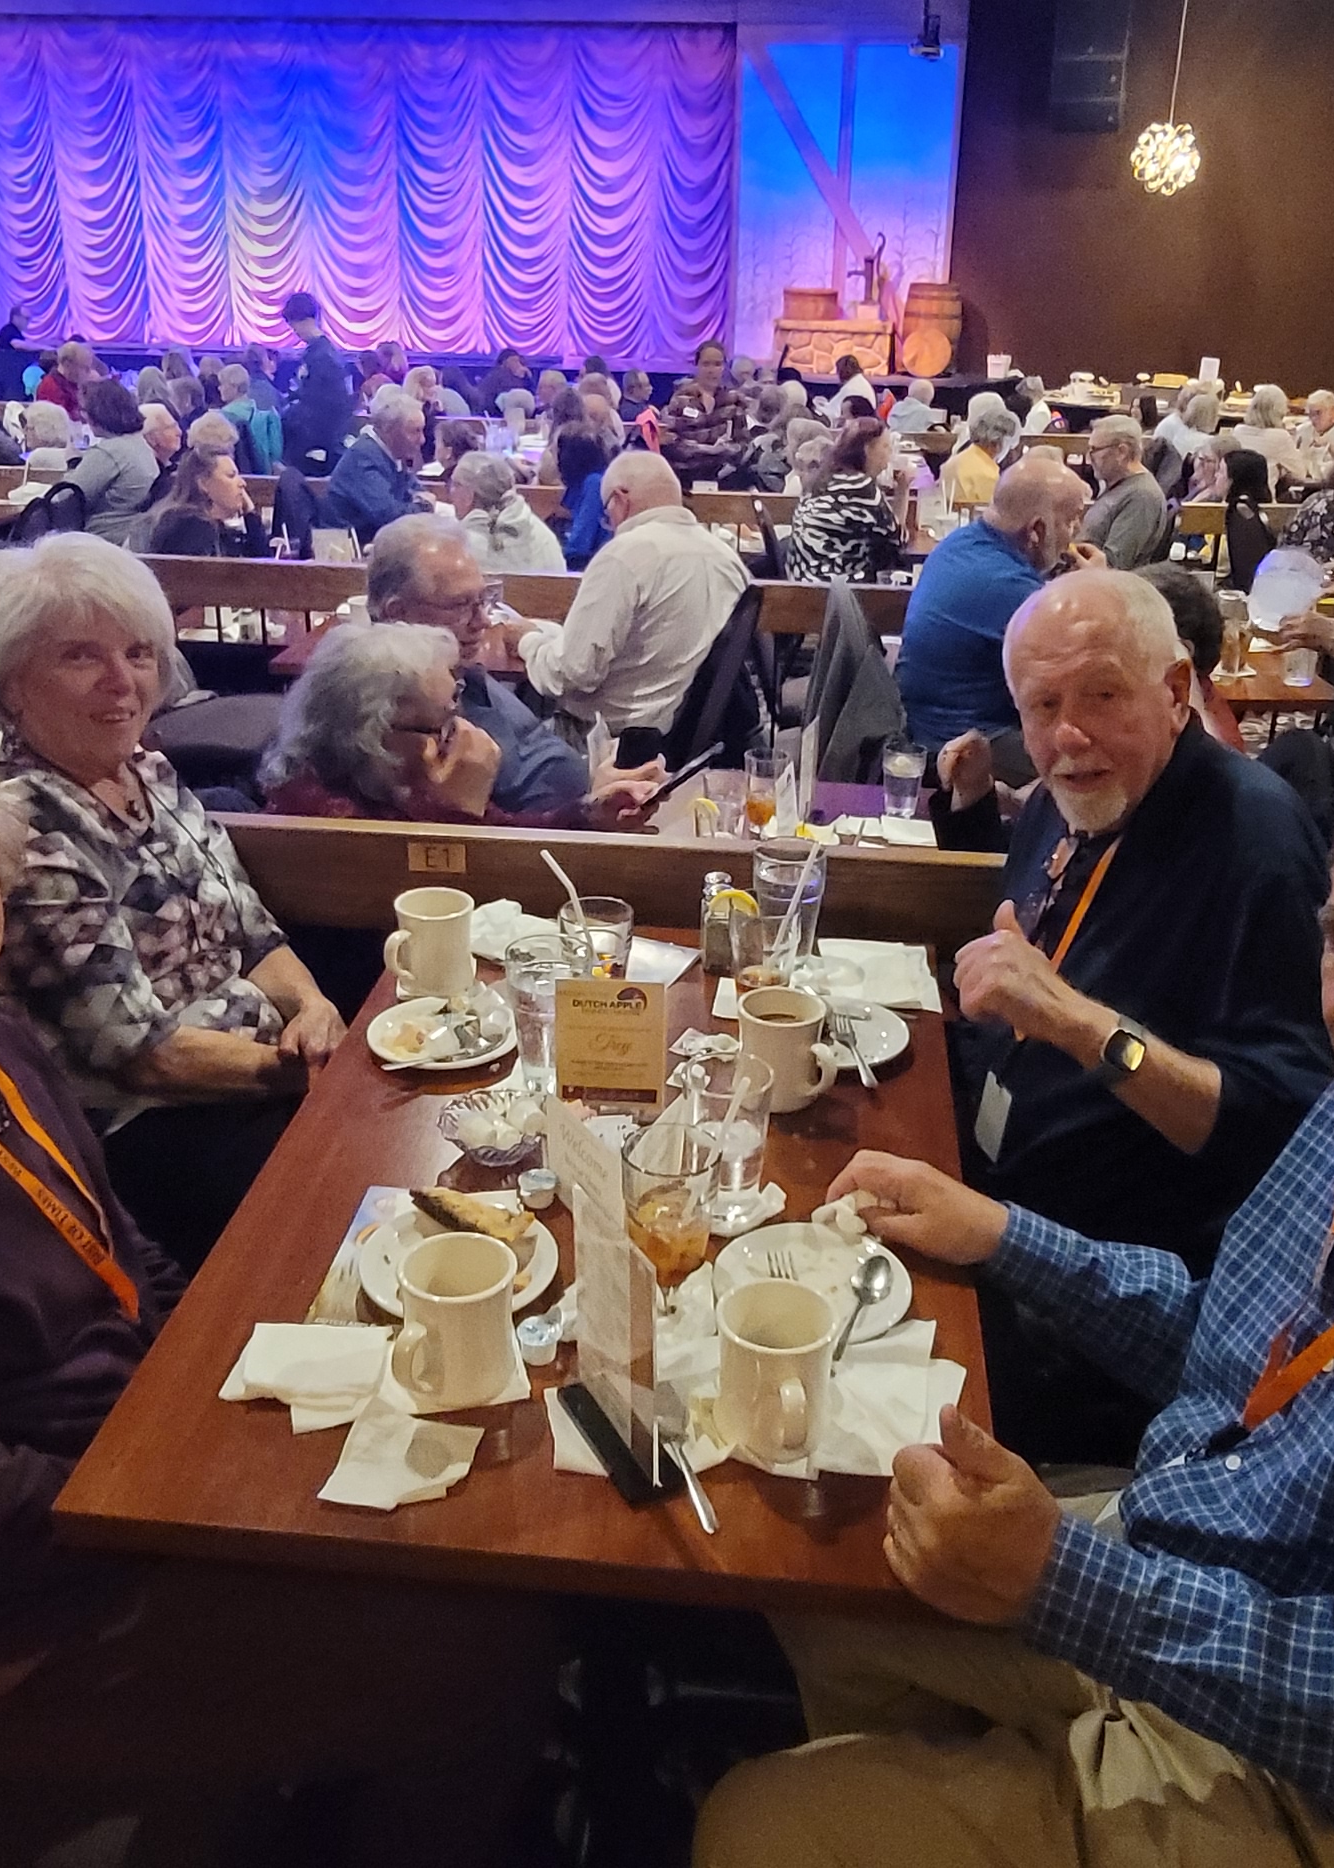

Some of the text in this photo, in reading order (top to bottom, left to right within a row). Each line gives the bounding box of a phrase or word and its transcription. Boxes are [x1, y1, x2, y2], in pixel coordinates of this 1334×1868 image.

[425, 846, 450, 868] E1
[572, 998, 642, 1010] DUTCH APPLE
